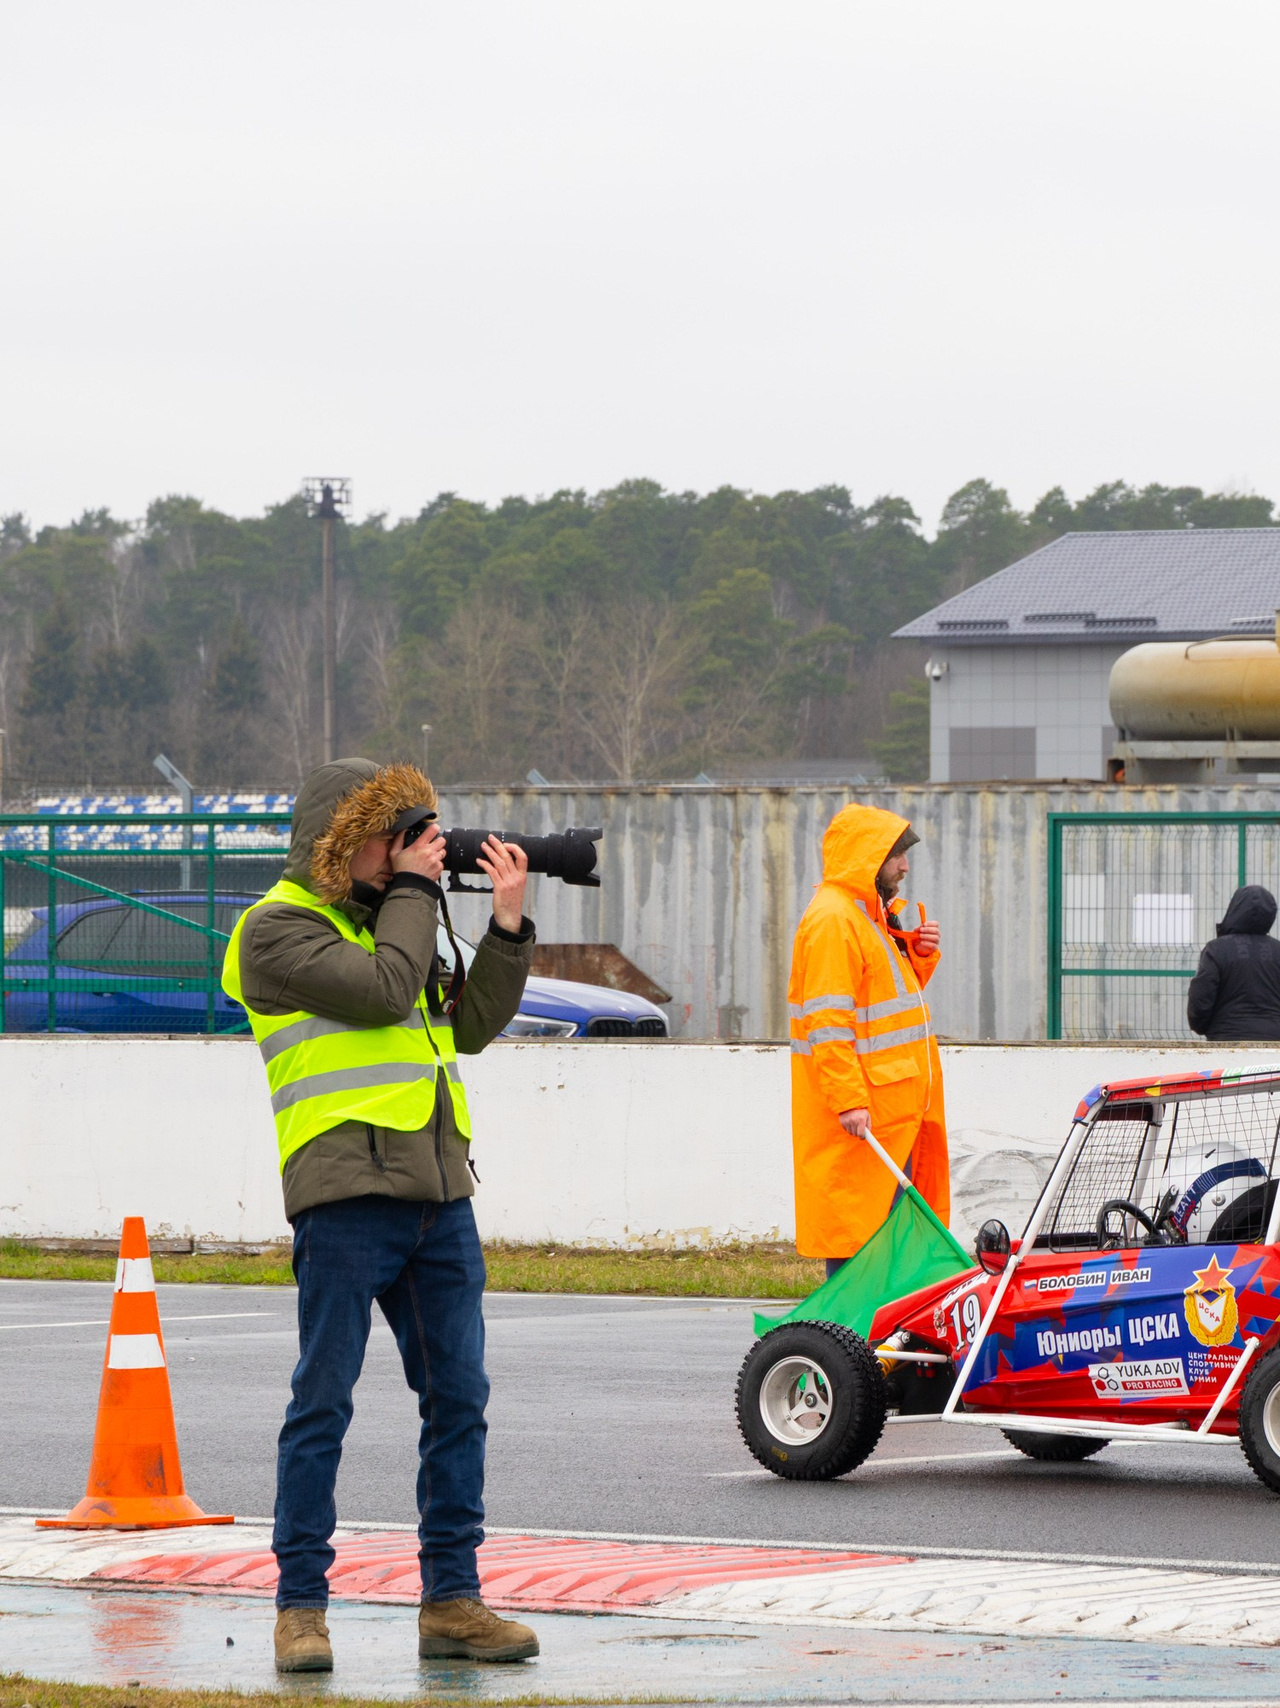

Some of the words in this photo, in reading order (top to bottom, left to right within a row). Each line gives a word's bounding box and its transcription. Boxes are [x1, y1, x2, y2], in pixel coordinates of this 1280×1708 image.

[1174, 1184, 1197, 1222] LEATT
[1039, 1274, 1106, 1290] БОЛОБИН
[1111, 1269, 1150, 1283] ИВАН
[1198, 1302, 1221, 1322] ЦСКА
[950, 1292, 982, 1353] 19
[1036, 1325, 1122, 1357] Юниоры
[1127, 1312, 1181, 1347] ЦСКА
[1187, 1351, 1240, 1361] ЦЕНТРАЛЬНЫ
[1188, 1361, 1237, 1369] СПОРТИВНЫ
[1116, 1365, 1151, 1378] YUKA
[1154, 1362, 1181, 1374] ADV
[1125, 1382, 1144, 1391] PRO
[1146, 1379, 1178, 1388] RACING
